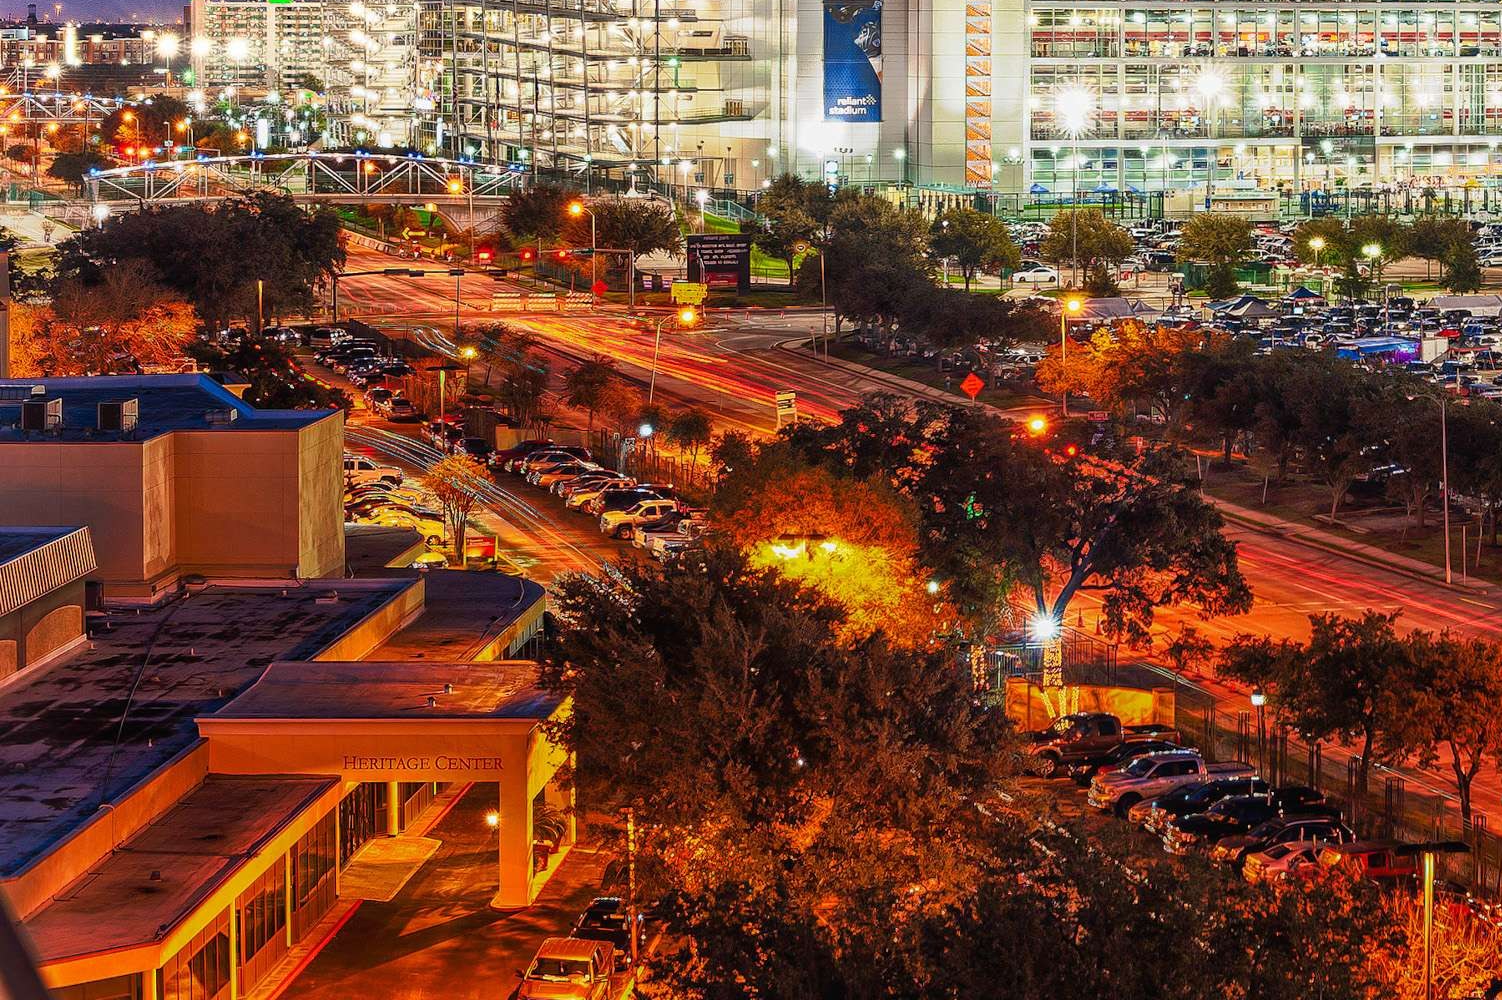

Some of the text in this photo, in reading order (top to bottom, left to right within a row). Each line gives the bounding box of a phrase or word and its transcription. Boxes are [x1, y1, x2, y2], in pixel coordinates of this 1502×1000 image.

[837, 96, 867, 106] reliant
[828, 106, 867, 115] stadium
[343, 755, 504, 770] HERITAGE CENTER
